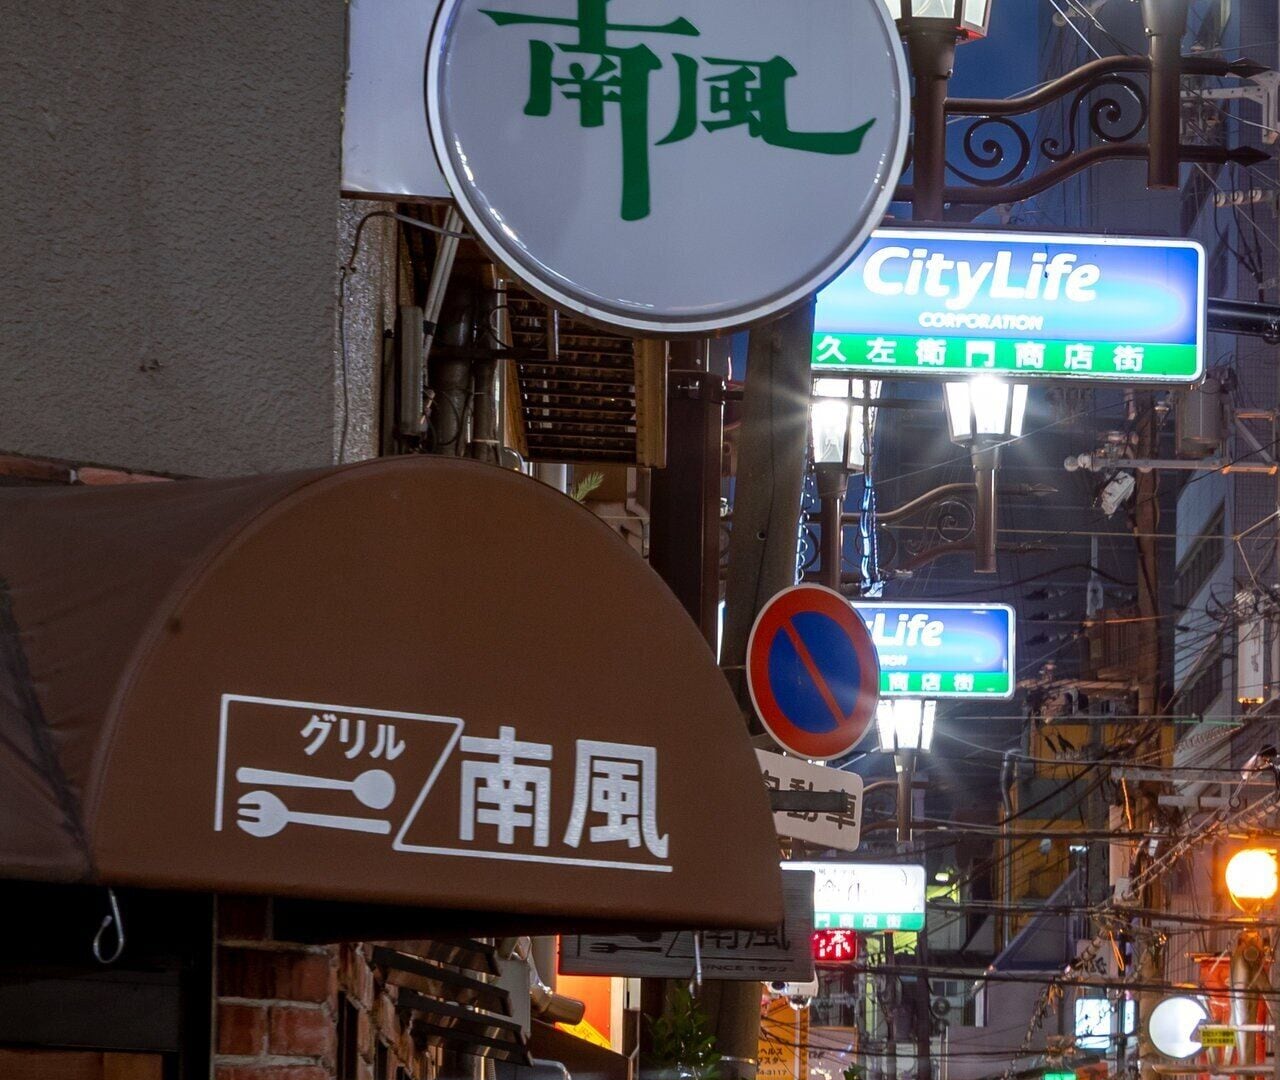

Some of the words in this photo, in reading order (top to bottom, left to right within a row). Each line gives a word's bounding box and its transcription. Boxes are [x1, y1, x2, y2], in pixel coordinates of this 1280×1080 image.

[477, 0, 878, 222] 南風
[863, 246, 1101, 310] CityLife
[918, 311, 1044, 331] CORPORATION
[816, 336, 1145, 373] 久左衛門商店街
[867, 613, 945, 648] Life
[301, 713, 406, 760] グリル
[459, 725, 669, 859] 南風
